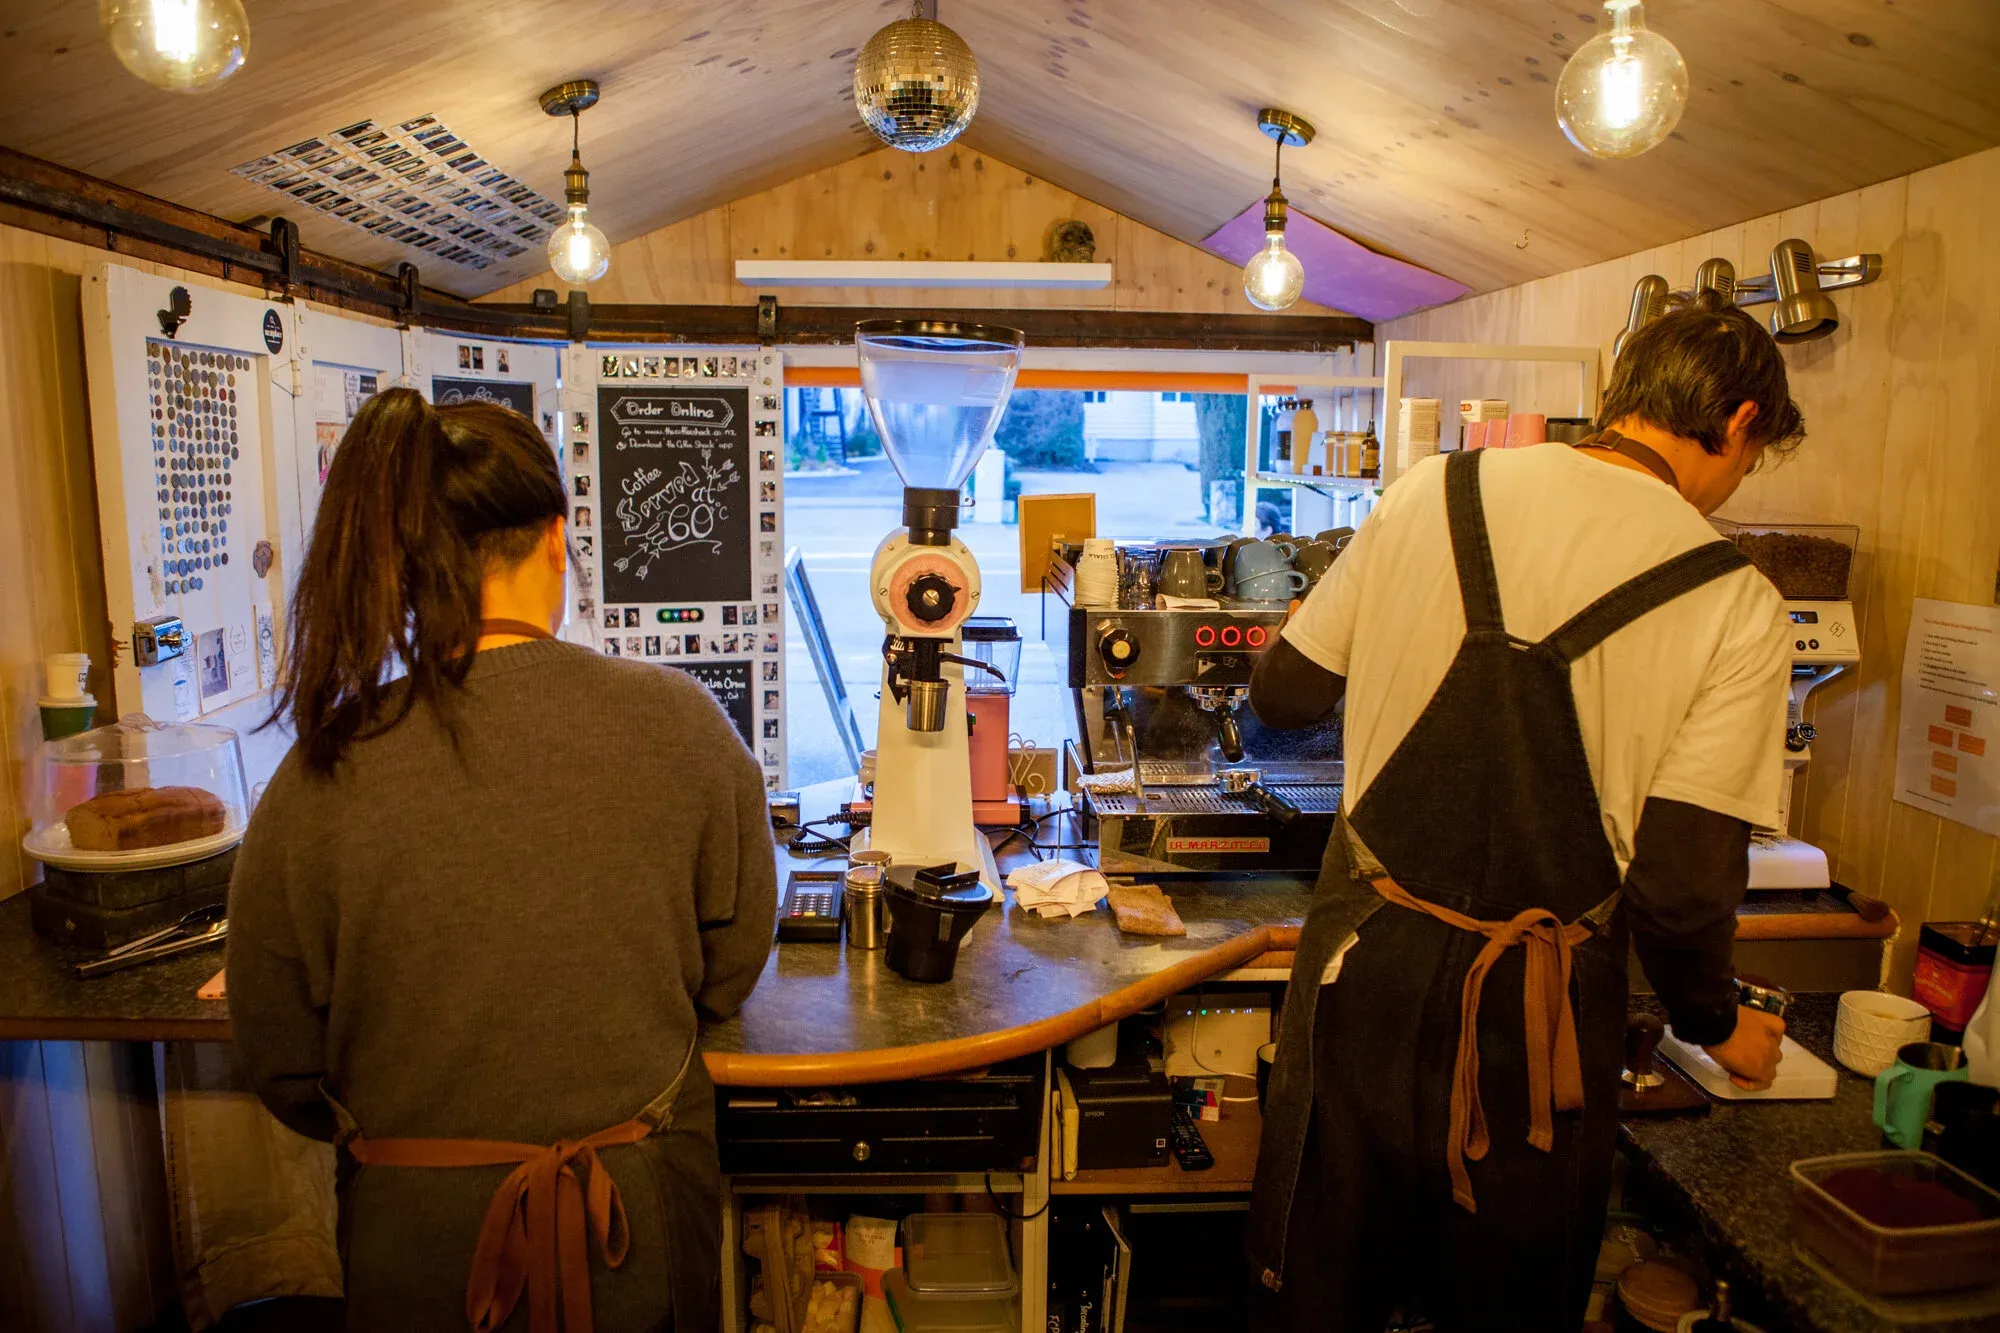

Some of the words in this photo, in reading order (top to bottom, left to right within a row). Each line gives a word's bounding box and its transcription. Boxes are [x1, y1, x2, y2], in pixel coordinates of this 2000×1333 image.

[625, 401, 664, 416] Order
[670, 401, 715, 418] Online
[621, 426, 632, 438] Go
[633, 427, 641, 435] to
[629, 438, 662, 448] Download
[622, 467, 662, 495] Coffee
[691, 474, 716, 504] at
[616, 461, 700, 532] Served
